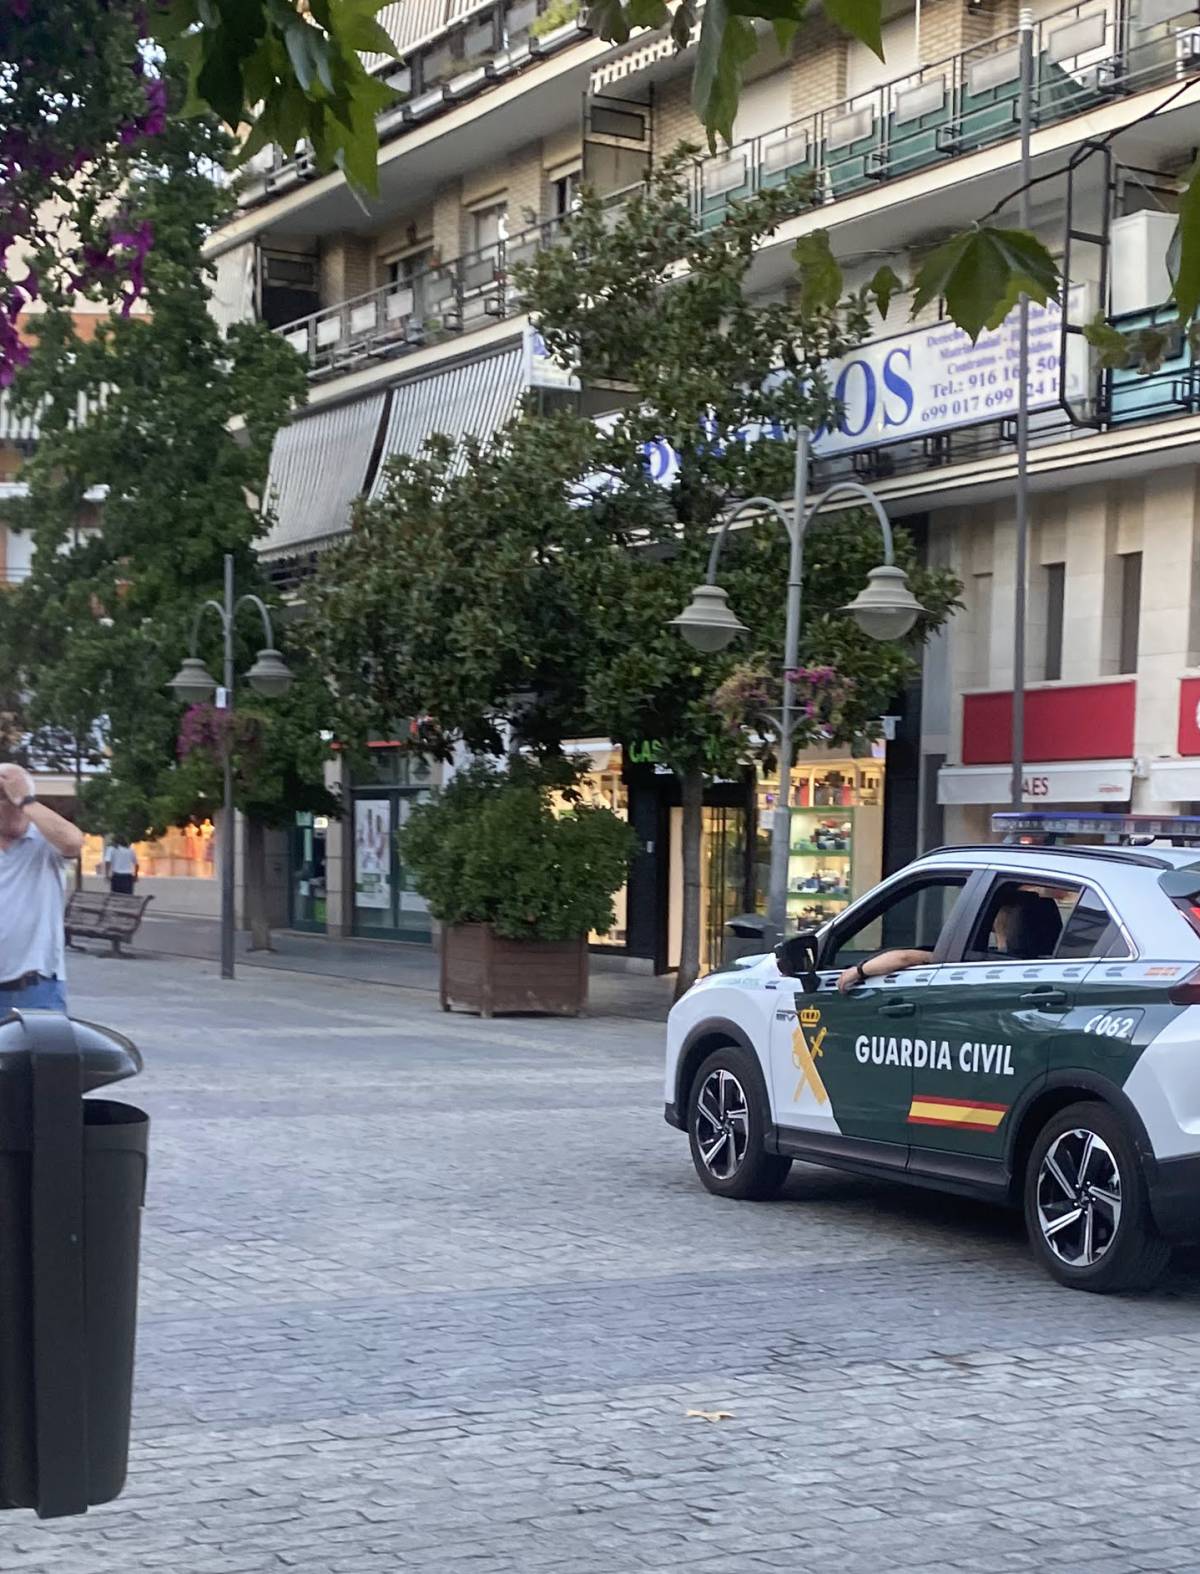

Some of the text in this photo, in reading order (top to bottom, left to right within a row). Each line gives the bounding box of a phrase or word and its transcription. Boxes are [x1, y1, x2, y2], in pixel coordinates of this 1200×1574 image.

[968, 370, 997, 388] 916
[1004, 364, 1030, 383] 16
[1037, 354, 1063, 373] 50
[921, 406, 948, 423] 699
[952, 396, 980, 415] 017
[985, 387, 1014, 408] 699
[855, 1034, 1015, 1076] GUARDIA CIVIL
